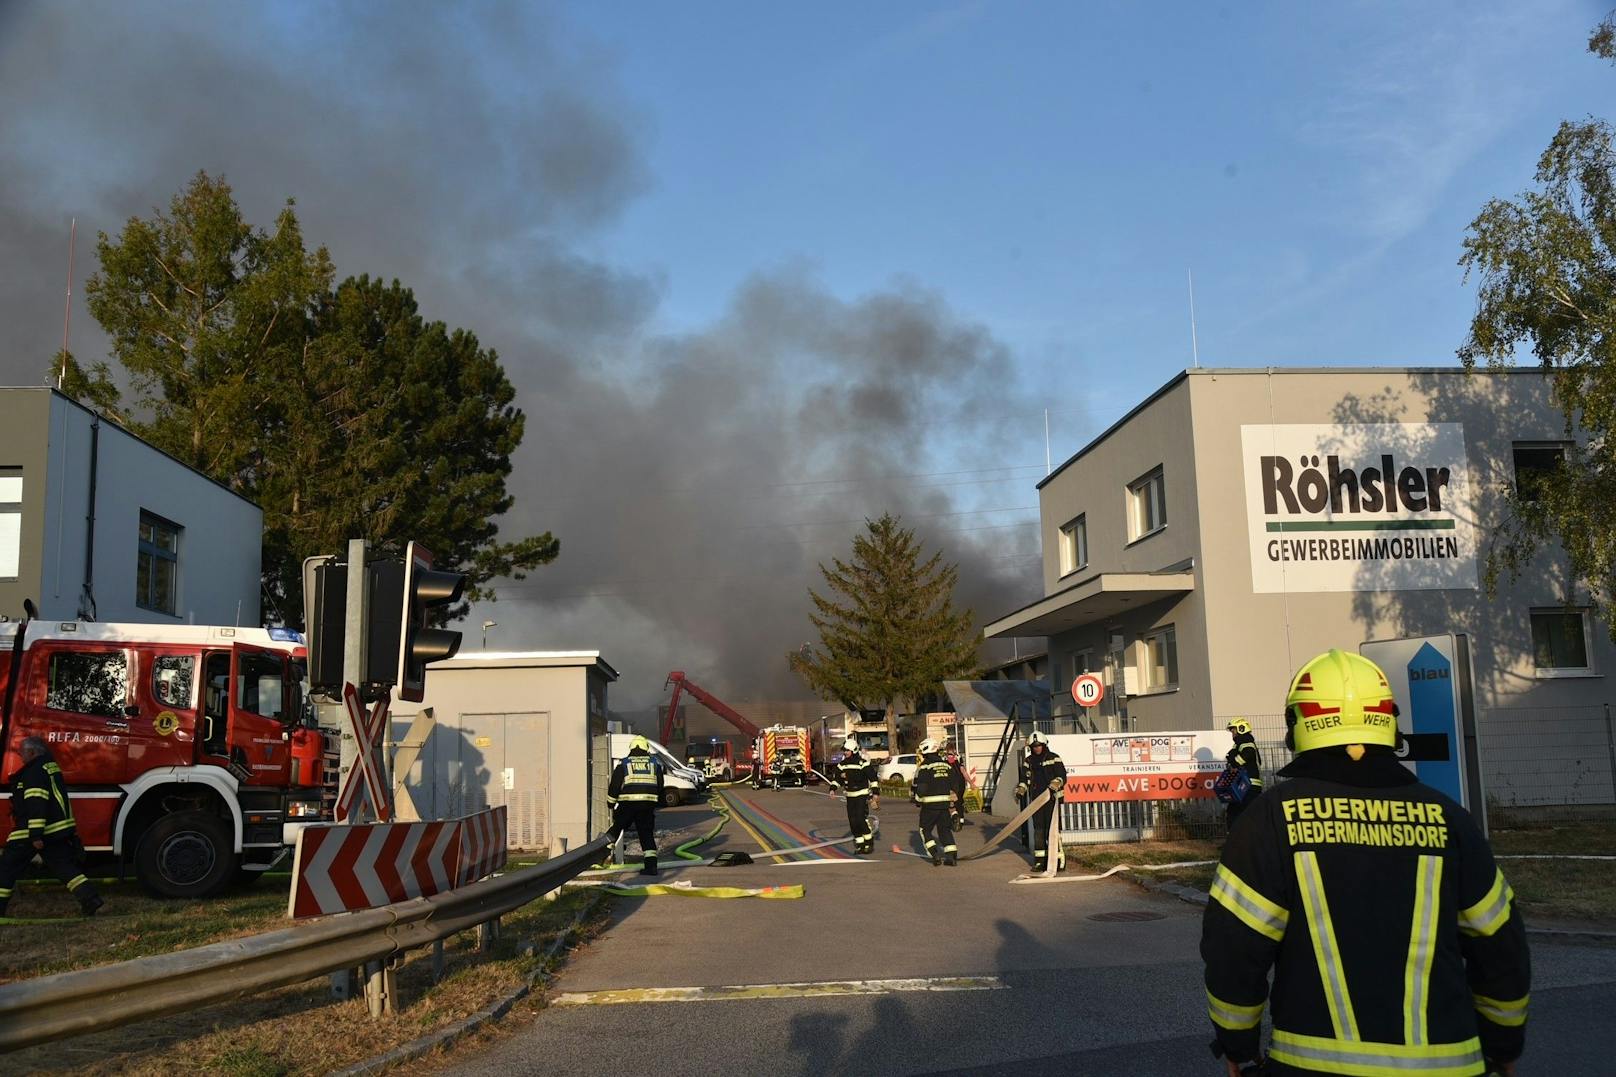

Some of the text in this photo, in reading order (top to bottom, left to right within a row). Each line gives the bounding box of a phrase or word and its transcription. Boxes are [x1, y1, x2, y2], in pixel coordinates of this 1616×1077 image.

[1260, 454, 1450, 515] Röhsler
[1267, 536, 1458, 562] GEWERBEIMMOBILIEN
[1410, 666, 1449, 681] blau
[1081, 683, 1094, 698] 10
[1304, 714, 1390, 732] FEUER WEHR
[48, 731, 80, 742] RLFA
[1112, 739, 1129, 747] AVE
[1150, 738, 1169, 746] DOG
[1122, 765, 1161, 773] TRAINIEREN
[1282, 797, 1446, 824] FEUERWEHR
[1287, 820, 1448, 848] BIEDERMANNSDORF
